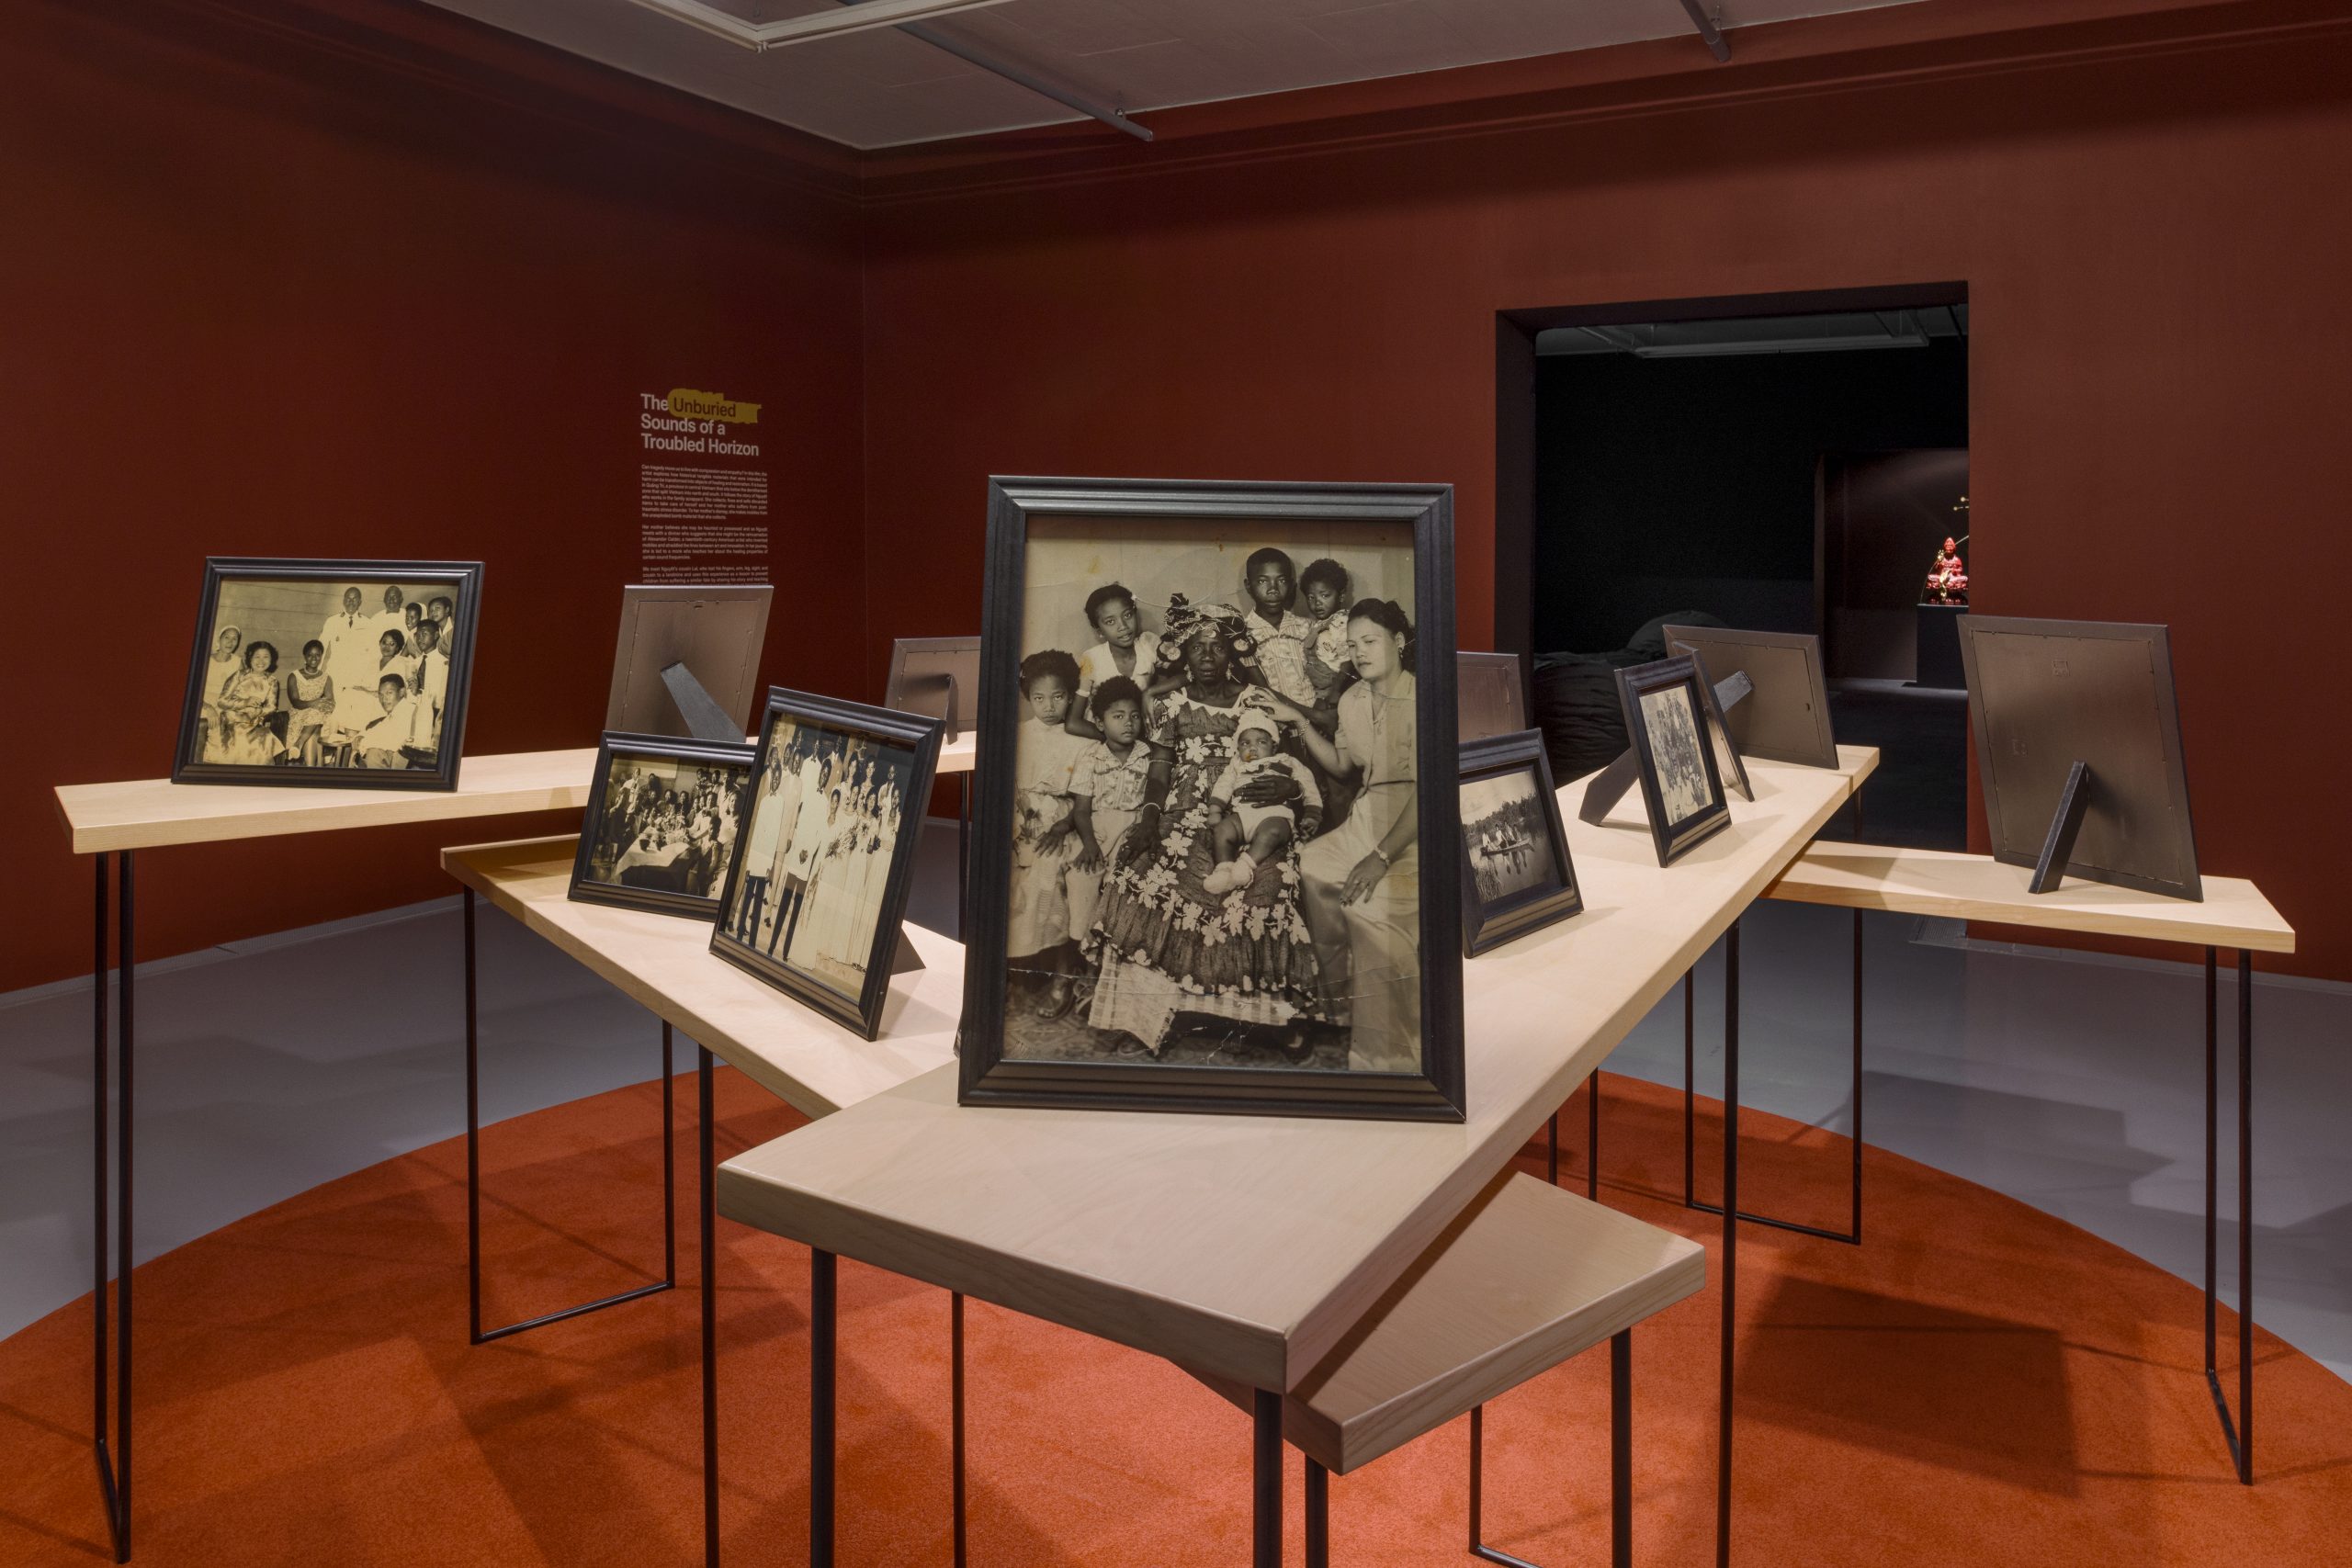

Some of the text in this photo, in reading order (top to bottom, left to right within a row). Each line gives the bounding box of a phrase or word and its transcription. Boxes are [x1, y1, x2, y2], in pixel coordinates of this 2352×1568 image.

[640, 393, 736, 417] The Unburied
[640, 413, 726, 435] Sounds of a
[641, 434, 760, 457] Troubled Horizon
